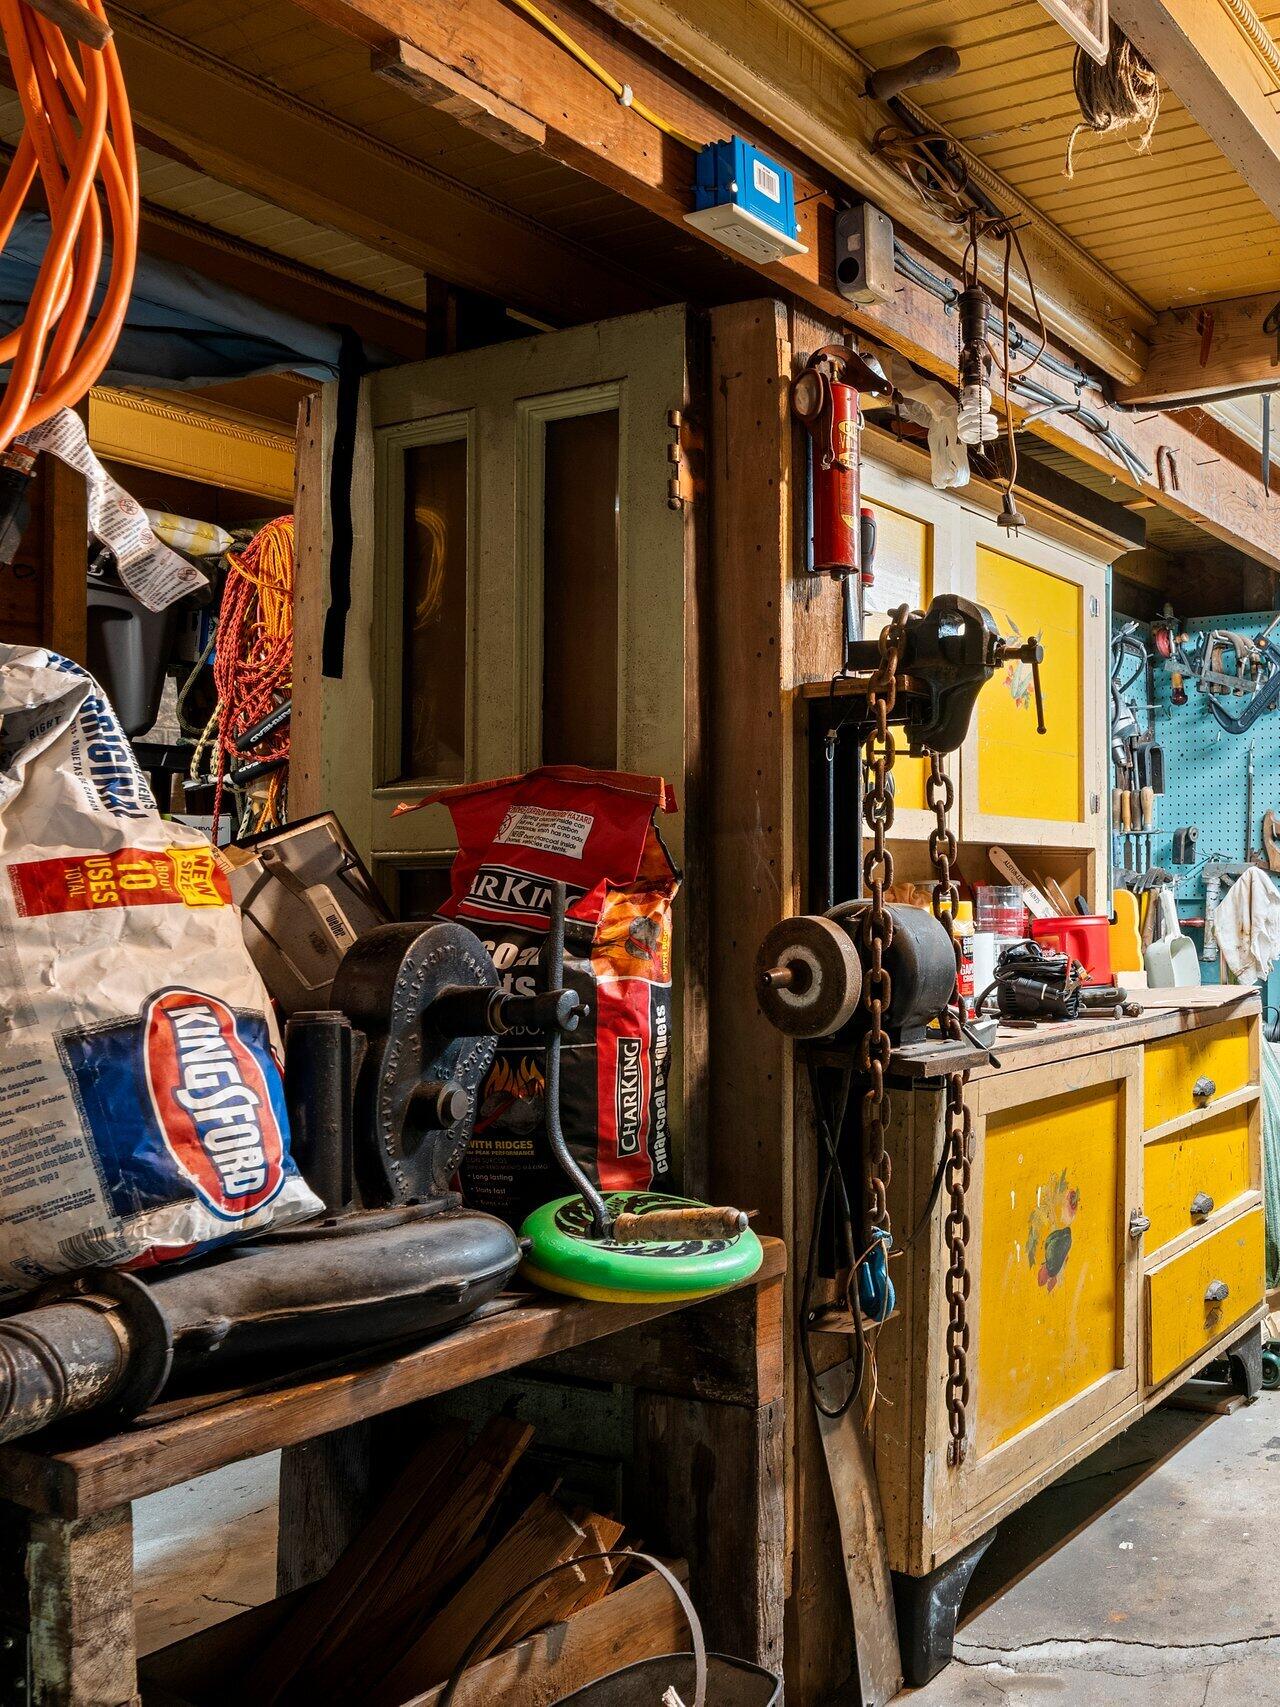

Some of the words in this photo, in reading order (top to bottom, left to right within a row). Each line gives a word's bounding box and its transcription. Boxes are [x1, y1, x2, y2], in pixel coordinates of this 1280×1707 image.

[29, 715, 62, 741] RIGHT
[80, 694, 149, 818] ORIGINAL
[557, 824, 579, 834] carbon
[568, 813, 593, 824] HAZARD
[551, 829, 561, 837] has
[560, 840, 576, 850] inside
[551, 844, 567, 853] tents.
[64, 866, 87, 898] TOTAL
[84, 857, 119, 904] USES
[116, 859, 158, 890] 10
[152, 859, 173, 893] ABOUT
[179, 861, 193, 891] SIZE
[191, 853, 218, 898] NEW
[393, 958, 415, 1020] U.S.A.
[16, 1059, 42, 1070] caliente
[167, 1004, 267, 1196] KINGSFORD
[619, 1041, 639, 1152] CHARKING
[1, 1148, 9, 1158] de
[9, 1140, 38, 1155] California
[39, 1134, 56, 1145] como
[34, 1151, 43, 1159] en
[43, 1147, 50, 1156] el
[50, 1141, 73, 1154] estado
[73, 1138, 82, 1147] de
[495, 1141, 533, 1149] RIDGES
[41, 1159, 58, 1170] otros
[78, 1148, 85, 1158] al
[39, 1173, 54, 1184] vaya
